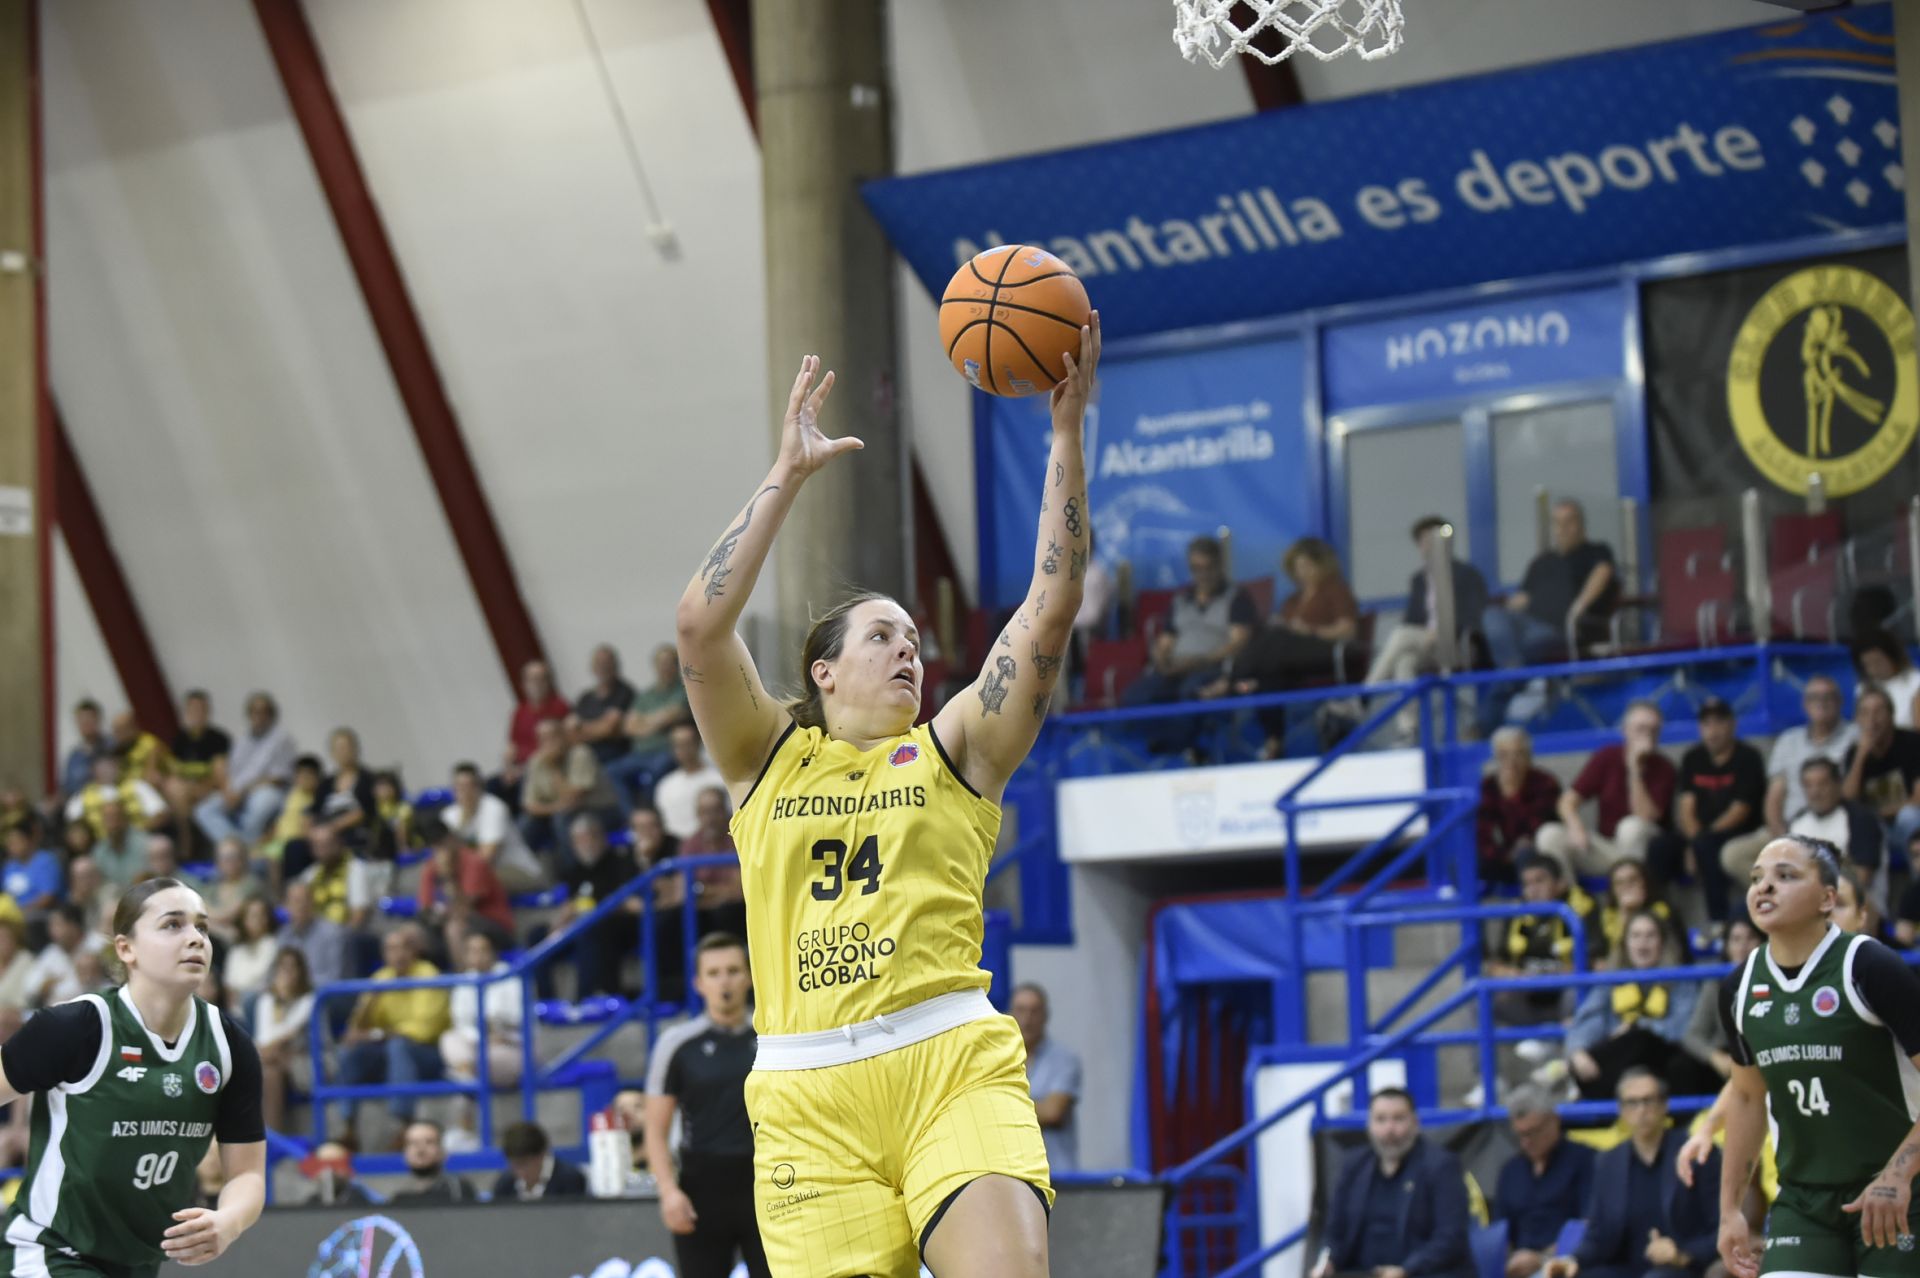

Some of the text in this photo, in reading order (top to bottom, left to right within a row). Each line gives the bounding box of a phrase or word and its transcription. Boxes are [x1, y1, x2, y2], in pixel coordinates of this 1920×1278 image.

[953, 123, 1764, 284] Aantarilla es deporte
[1102, 425, 1275, 477] Alcantarilla
[811, 834, 884, 901] 34
[797, 922, 870, 952] GRUPO
[798, 937, 896, 973] HOZONO
[798, 961, 881, 993] GLOBAL
[1749, 1000, 1774, 1018] 4F
[1771, 1044, 1800, 1064] UMCS
[1801, 1044, 1843, 1061] LUBLIN
[116, 1066, 148, 1082] 4F
[1788, 1076, 1831, 1117] 24
[112, 1121, 138, 1137] AZS
[141, 1121, 178, 1137] UMCS
[132, 1151, 180, 1191] 90
[766, 1189, 821, 1213] Costa Cálida
